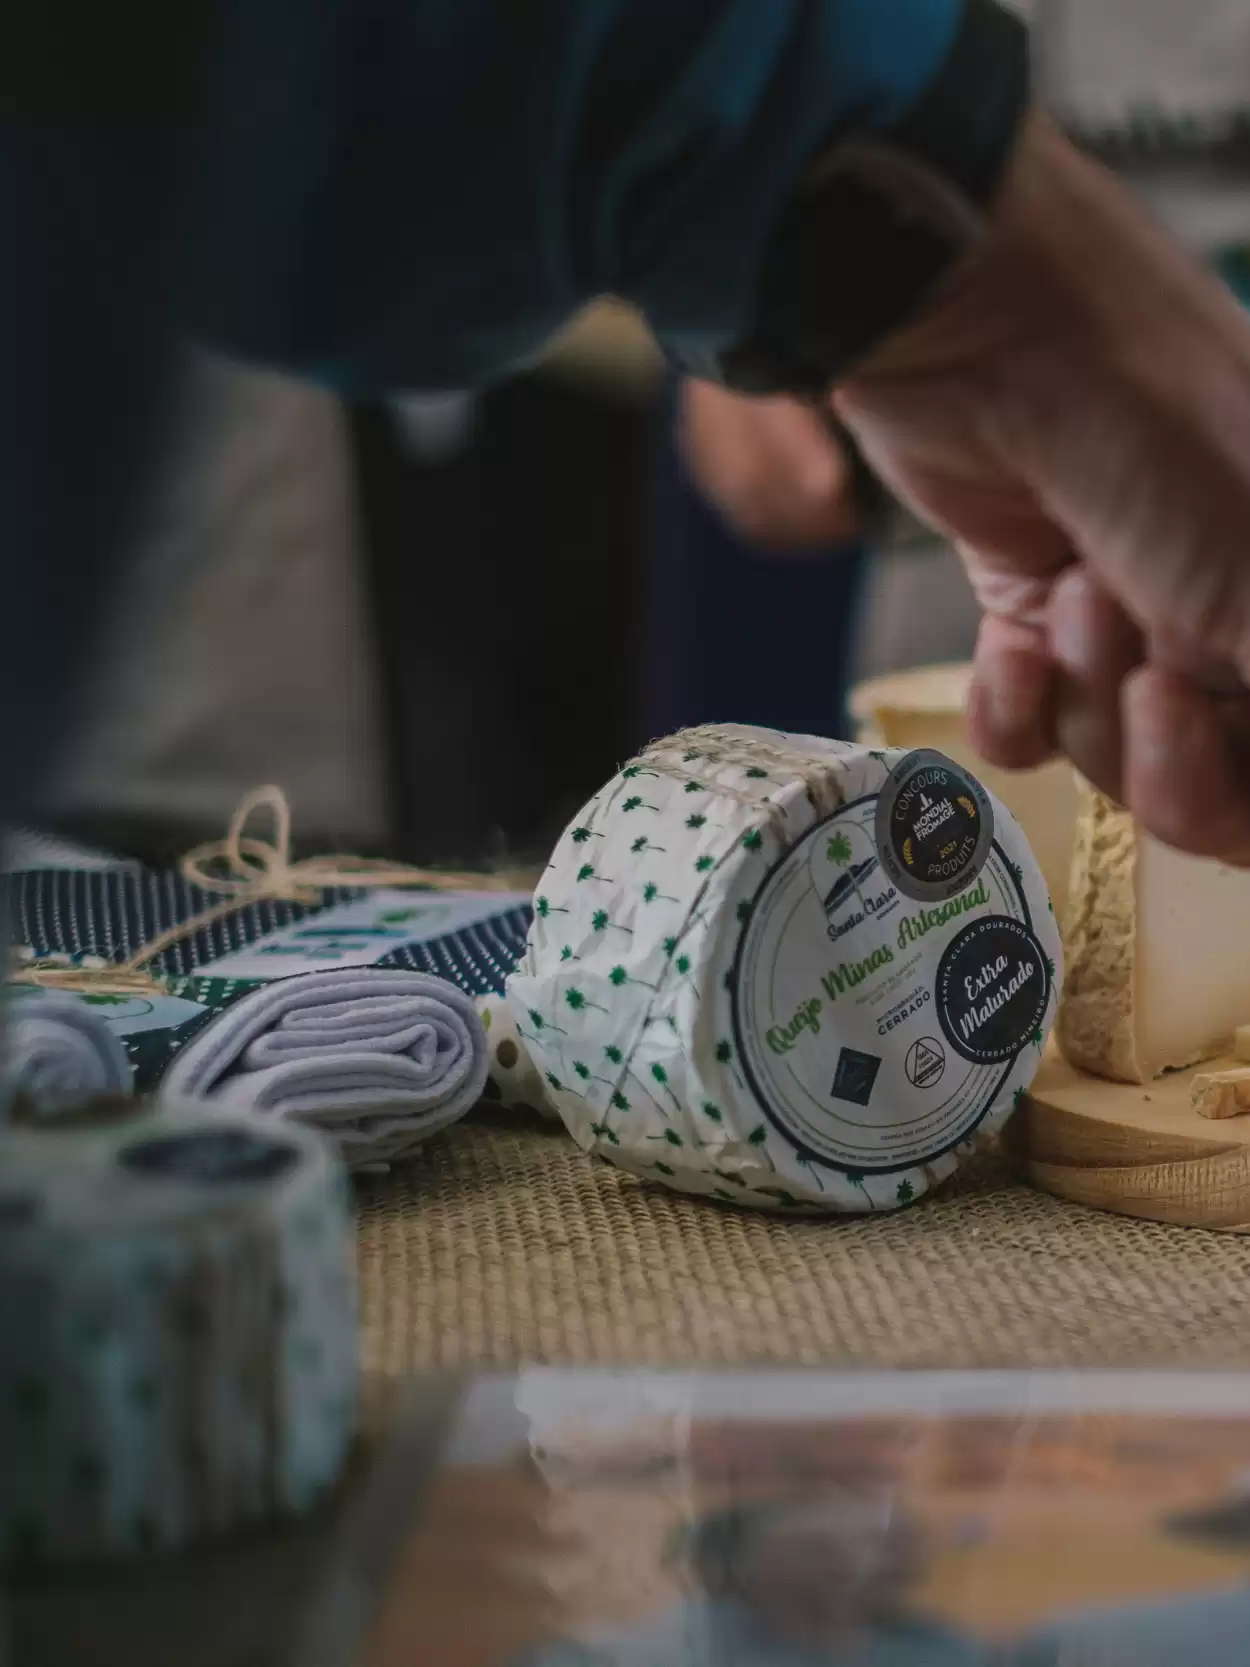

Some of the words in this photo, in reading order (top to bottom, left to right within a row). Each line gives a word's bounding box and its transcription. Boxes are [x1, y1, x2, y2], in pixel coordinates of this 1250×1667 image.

[896, 770, 949, 820] CONCOURS
[913, 798, 952, 833] MONDIAL
[915, 804, 956, 841] FROMAGE
[927, 835, 975, 876] PRODUITS
[939, 840, 958, 859] 2021
[827, 912, 865, 942] Santa
[863, 887, 897, 915] Clara
[766, 996, 822, 1055] Queijo
[821, 944, 894, 1001] Minas
[897, 878, 991, 949] Artesanal
[942, 965, 953, 1002] SANTA
[951, 931, 976, 960] CLARA
[979, 921, 1028, 939] DOURADOS
[964, 954, 1009, 1001] Extra
[877, 990, 931, 1036] CERRADO
[959, 961, 1035, 1040] Maturado
[1020, 999, 1045, 1043] MINEIRO
